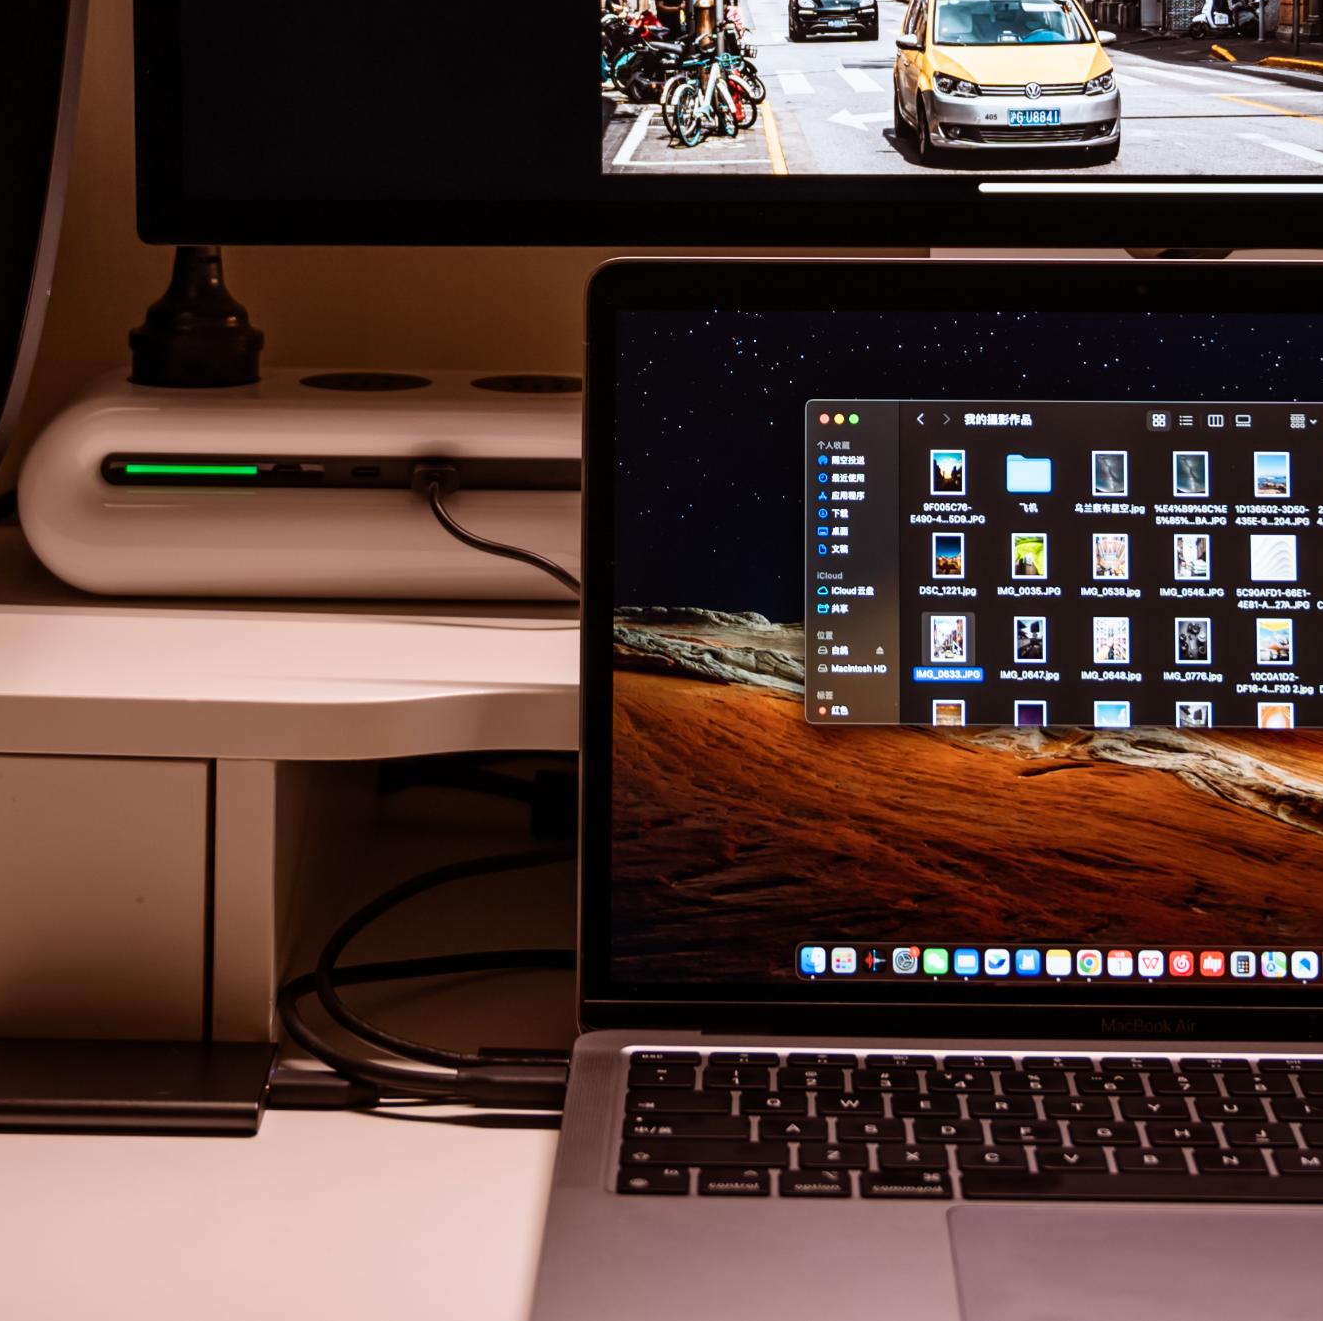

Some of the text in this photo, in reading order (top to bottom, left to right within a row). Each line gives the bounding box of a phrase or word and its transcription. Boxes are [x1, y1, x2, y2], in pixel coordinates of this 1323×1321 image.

[817, 440, 850, 449] 个人收藏
[817, 572, 843, 580] iCloud
[831, 586, 856, 595] iCloud
[831, 664, 887, 673] Macintosh HD
[1101, 1017, 1196, 1032] MacBook Air
[840, 1099, 859, 1108] W
[708, 1181, 760, 1189] control
[794, 1182, 841, 1192] option
[872, 1184, 943, 1192] command
